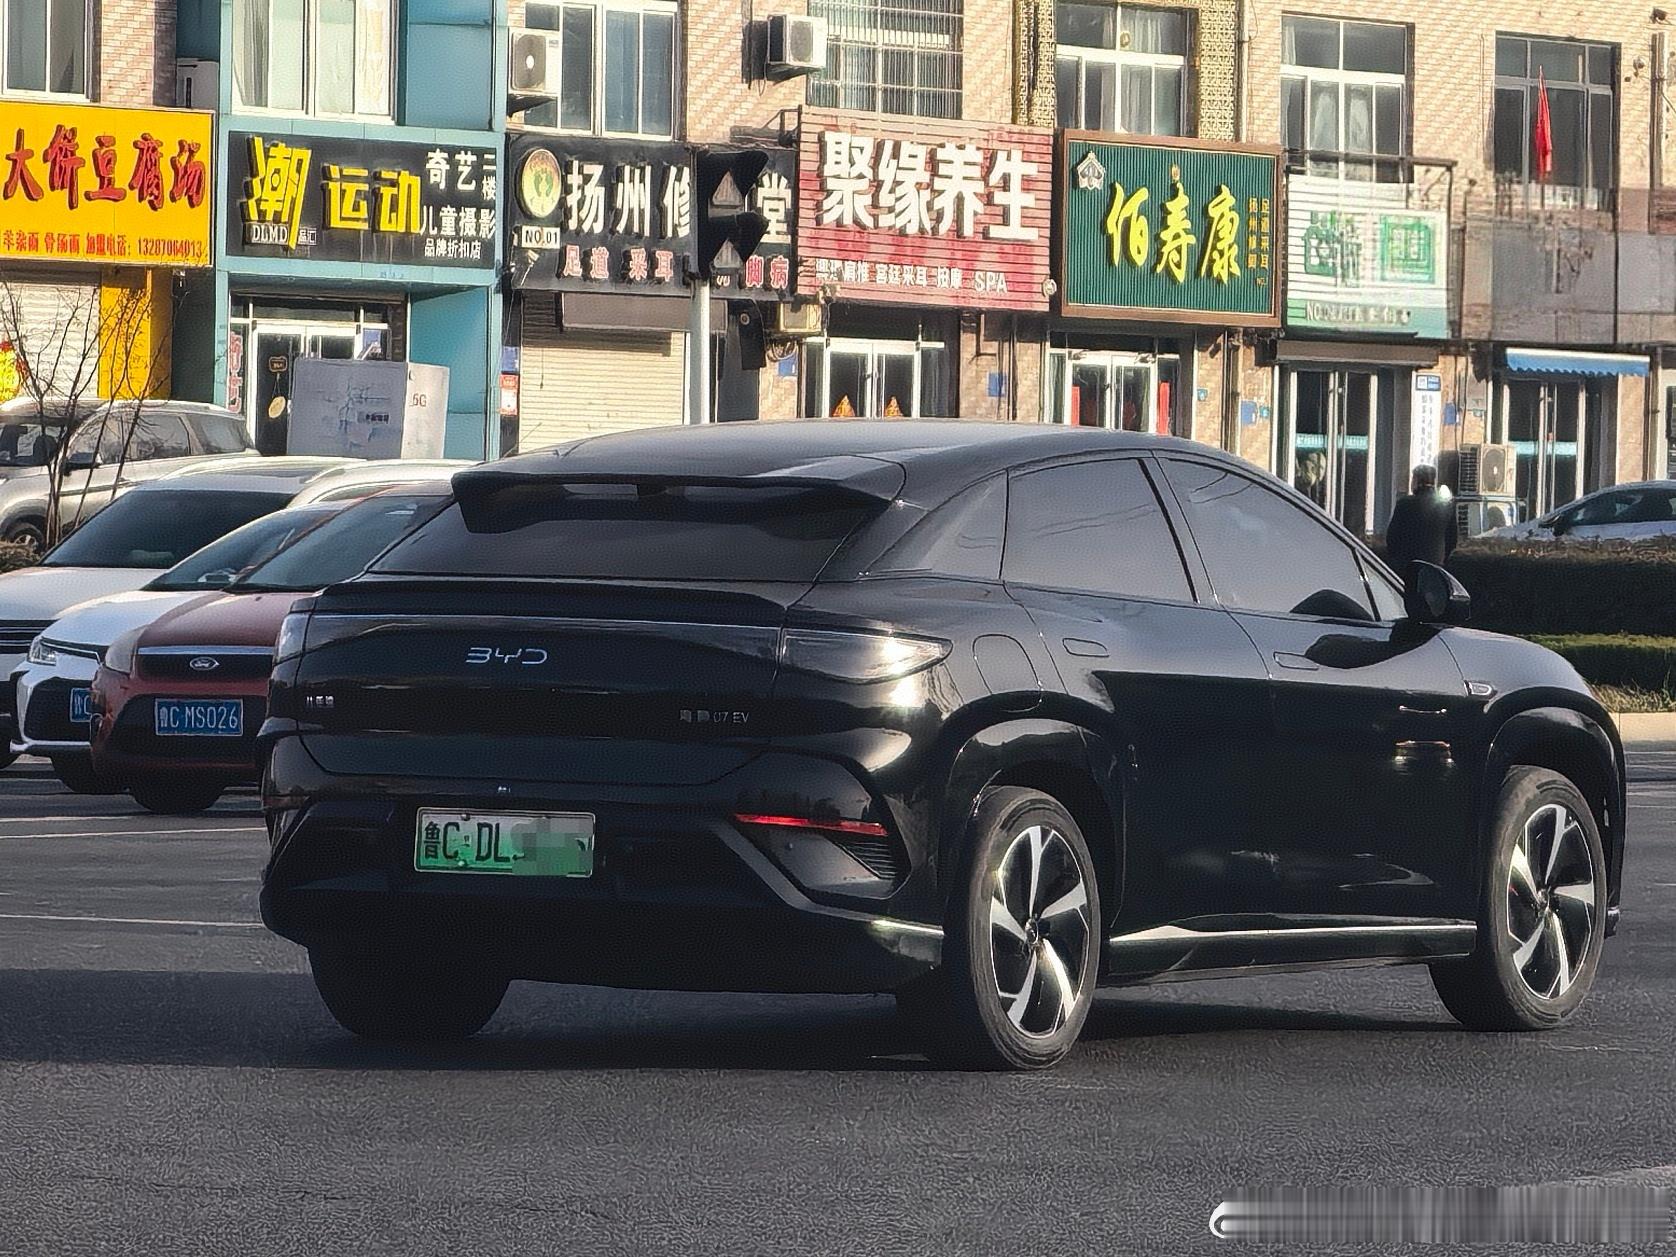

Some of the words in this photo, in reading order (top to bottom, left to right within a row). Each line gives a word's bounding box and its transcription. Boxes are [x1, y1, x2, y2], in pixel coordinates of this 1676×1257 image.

[425, 148, 478, 191] 奇艺
[823, 130, 1040, 241] 聚缘养生
[247, 135, 313, 250] 潮
[324, 163, 423, 234] 运动
[252, 224, 288, 245] DLMD
[421, 204, 497, 240] 儿童摄影
[1106, 182, 1242, 284] 伯寿康
[424, 238, 482, 260] 品牌折扣店
[974, 271, 1009, 293] SPA
[732, 711, 750, 723] EV
